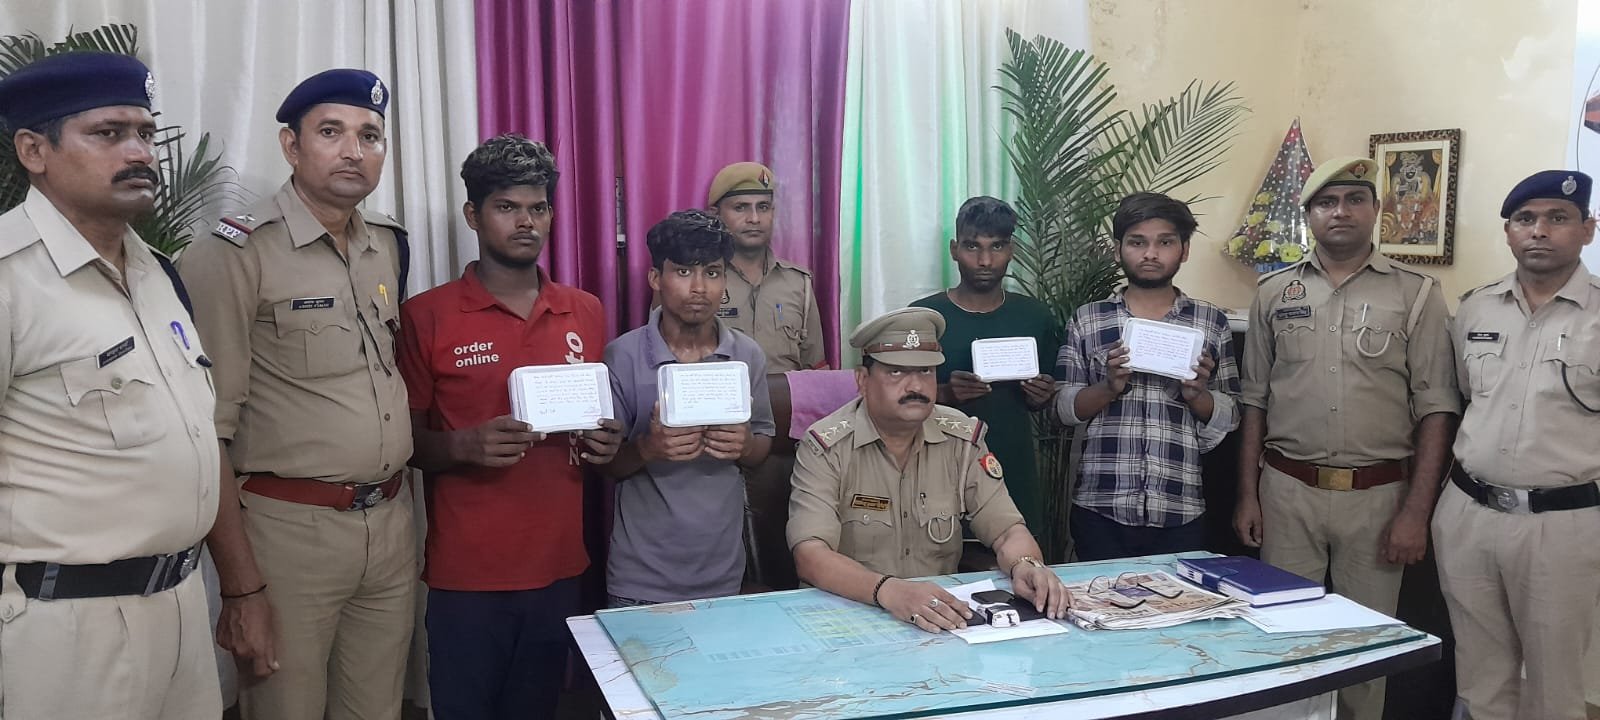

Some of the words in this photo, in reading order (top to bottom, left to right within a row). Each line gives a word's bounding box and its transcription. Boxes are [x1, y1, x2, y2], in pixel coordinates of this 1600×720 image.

[216, 221, 241, 239] RPF
[453, 341, 493, 355] order
[455, 354, 500, 368] online
